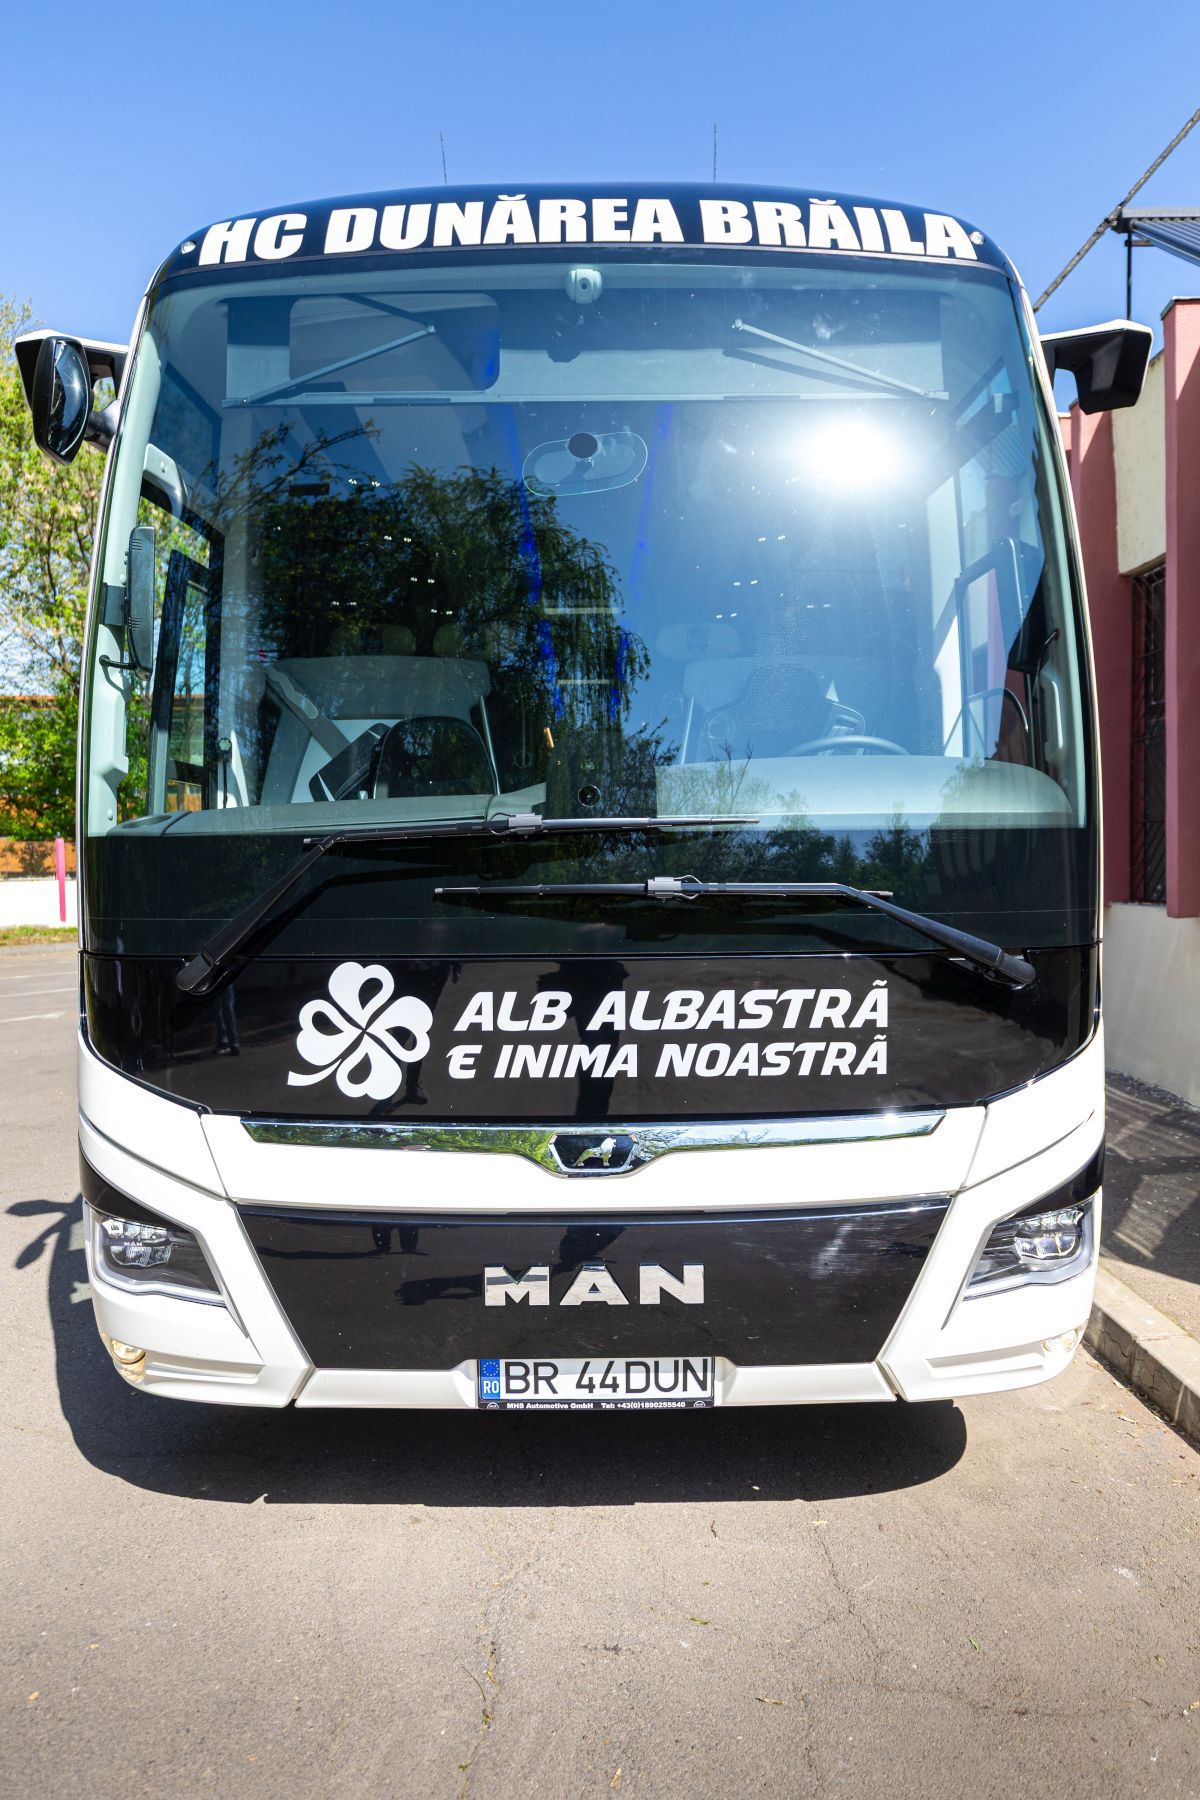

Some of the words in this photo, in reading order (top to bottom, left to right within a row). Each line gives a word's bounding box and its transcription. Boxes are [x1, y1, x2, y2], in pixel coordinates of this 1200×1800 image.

[198, 213, 308, 266] HC
[324, 194, 685, 254] DUNĂREA
[699, 198, 978, 260] BRĂILA
[454, 991, 574, 1032] ALB
[446, 1044, 483, 1079] E
[493, 1043, 638, 1078] INIMA
[484, 1263, 705, 1306] MAN
[483, 1380, 500, 1394] RO
[504, 1361, 559, 1394] BR
